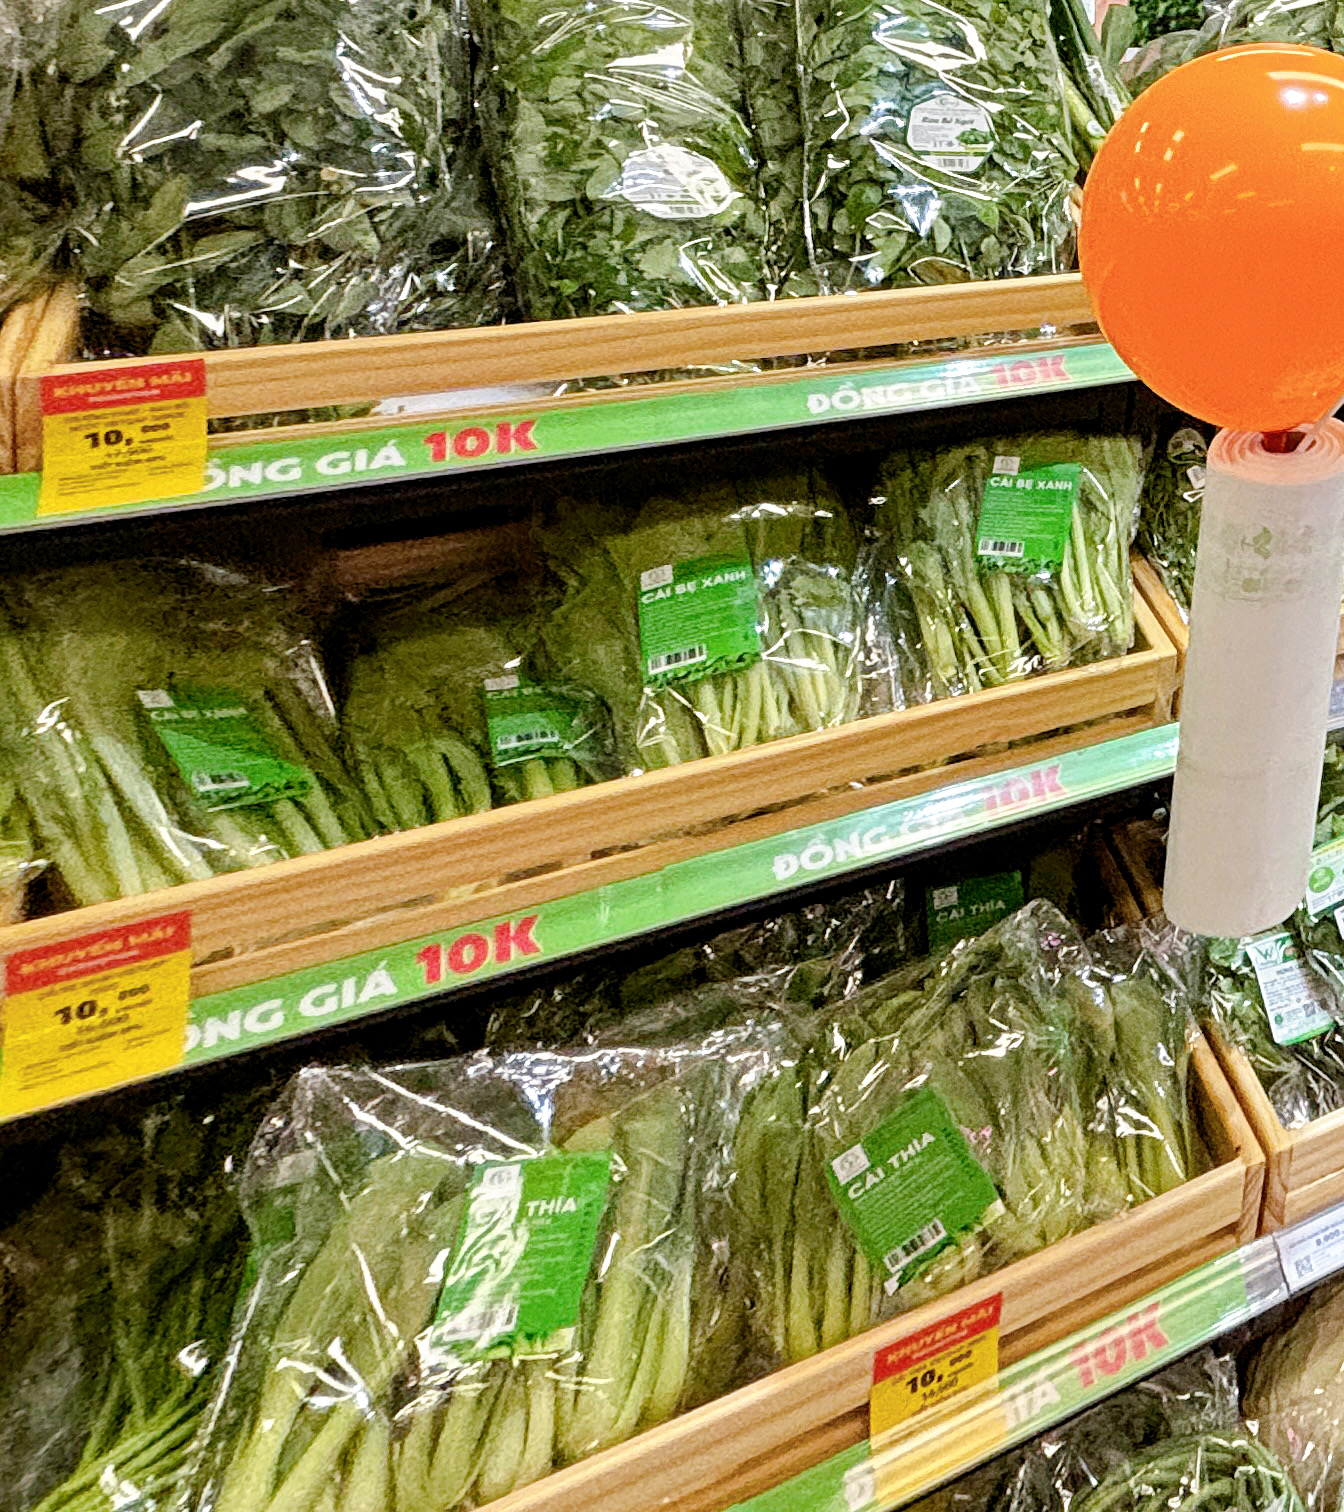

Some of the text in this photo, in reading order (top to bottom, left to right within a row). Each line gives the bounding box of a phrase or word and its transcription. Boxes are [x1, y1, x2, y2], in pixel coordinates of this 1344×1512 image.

[808, 382, 913, 414] ĐỒNG
[993, 355, 1072, 386] 10K
[316, 440, 406, 475] GIÁ
[424, 420, 538, 463] 10K
[772, 826, 891, 881] ĐỒNG
[981, 765, 1067, 816] 10K
[299, 960, 398, 1018] GIÁ
[416, 915, 542, 985] 10K
[1071, 1302, 1168, 1388] 10K
